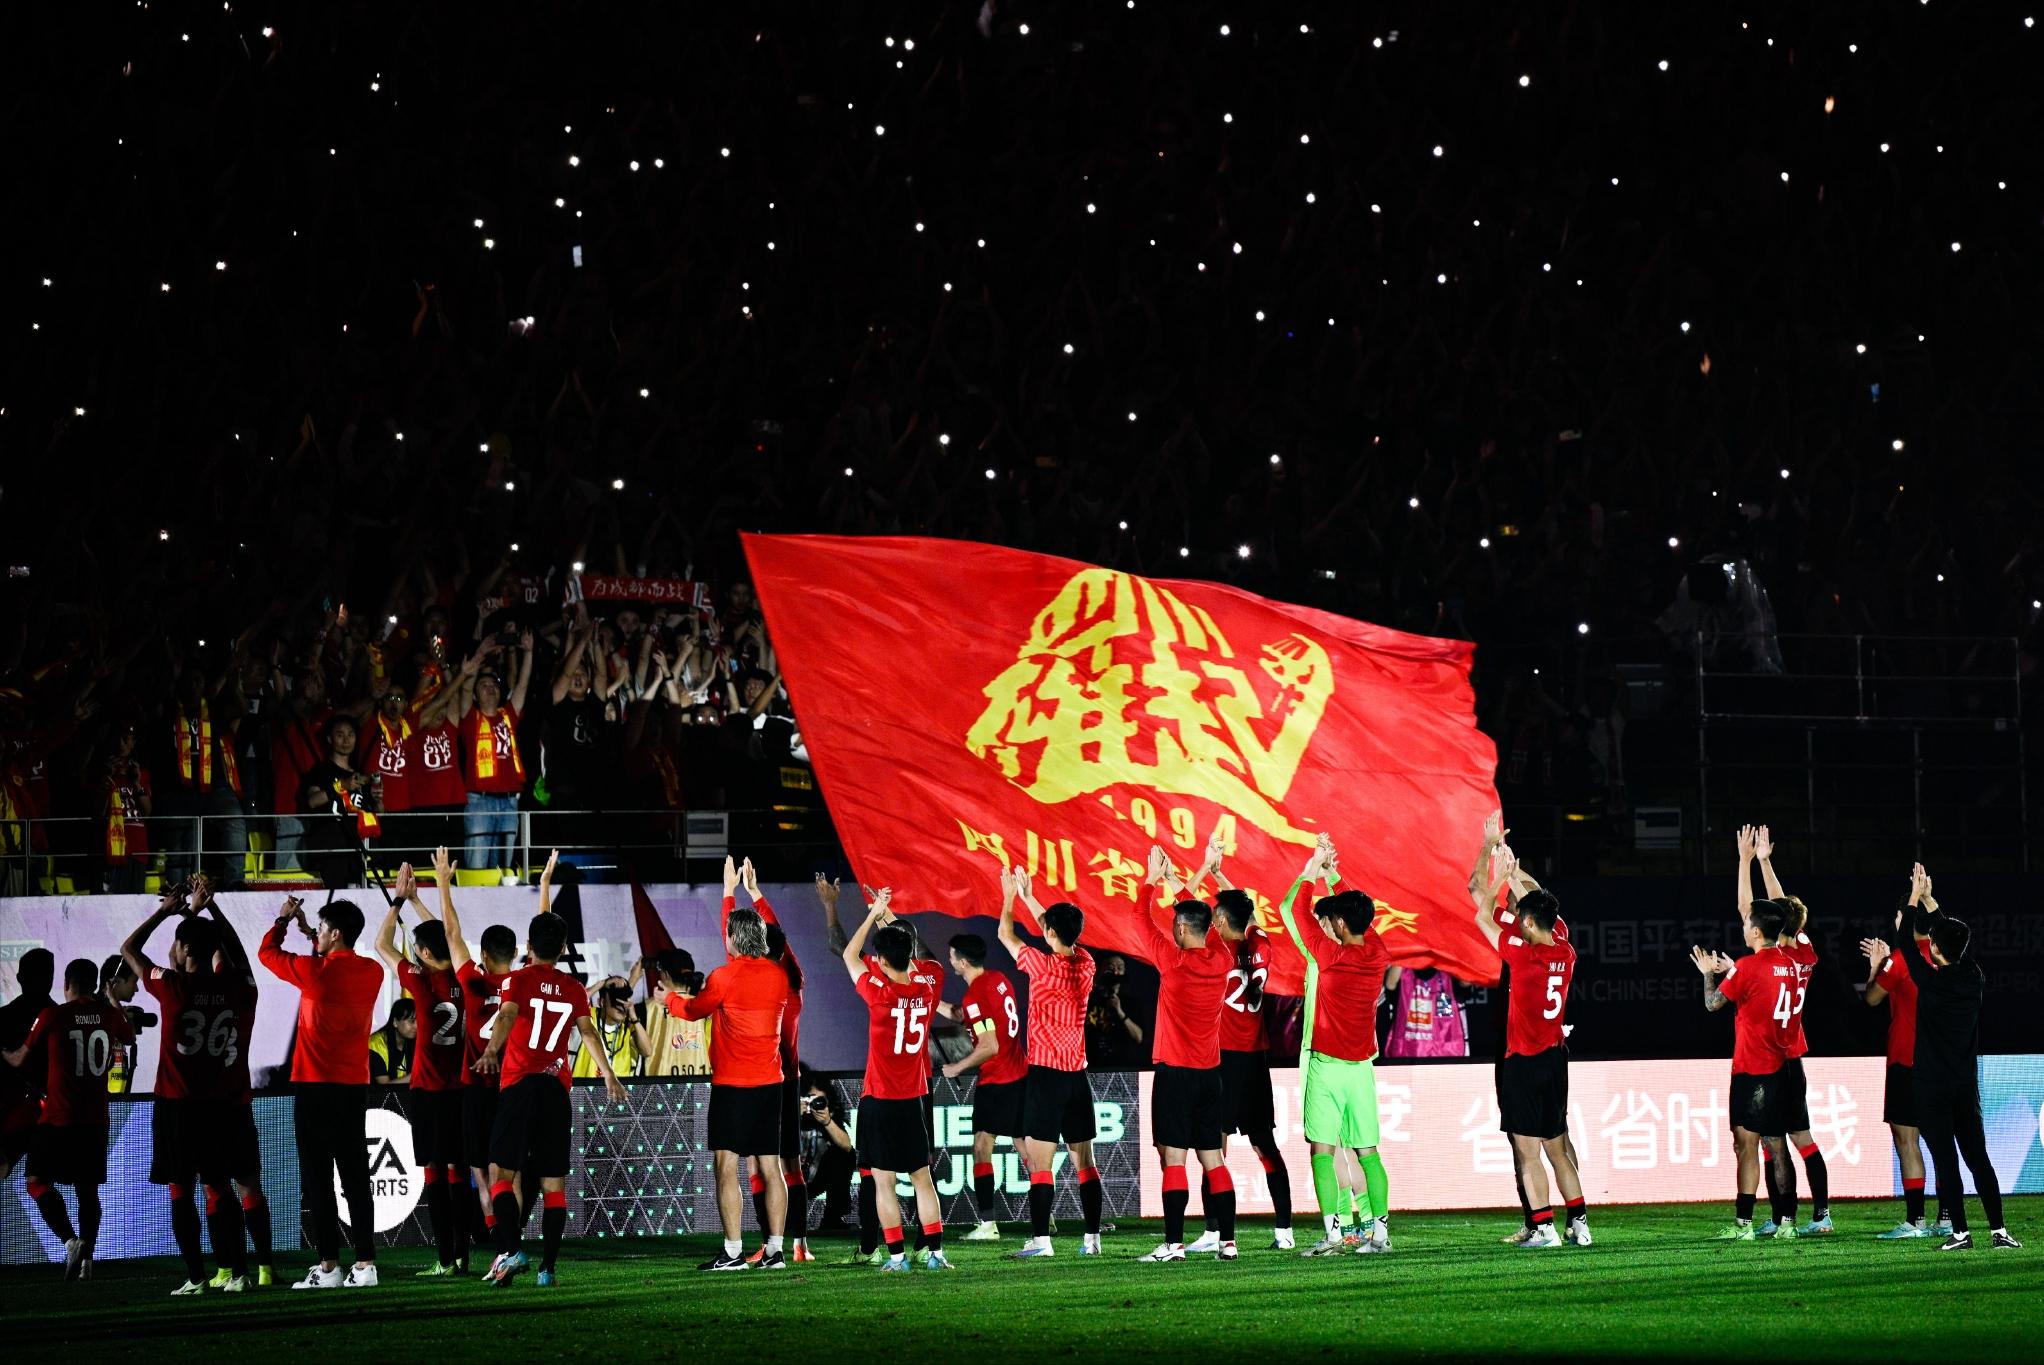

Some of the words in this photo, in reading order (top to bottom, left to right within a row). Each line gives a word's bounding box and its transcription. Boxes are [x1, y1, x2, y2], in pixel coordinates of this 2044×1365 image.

[541, 982, 553, 995] GAN
[1224, 968, 1267, 1013] 23
[1591, 977, 1689, 1001] CHINESE
[1773, 966, 1789, 977] ZHANG
[1986, 974, 2041, 993] UPER
[75, 1013, 101, 1025] ROMULO
[898, 998, 908, 1009] WU
[1004, 995, 1019, 1039] 8
[1543, 976, 1563, 1020] 5
[1773, 982, 1791, 1029] 4
[176, 1009, 234, 1057] 36
[432, 1002, 466, 1046] 2
[528, 997, 573, 1053] 17
[890, 1007, 928, 1055] 15
[68, 1029, 109, 1077] 10
